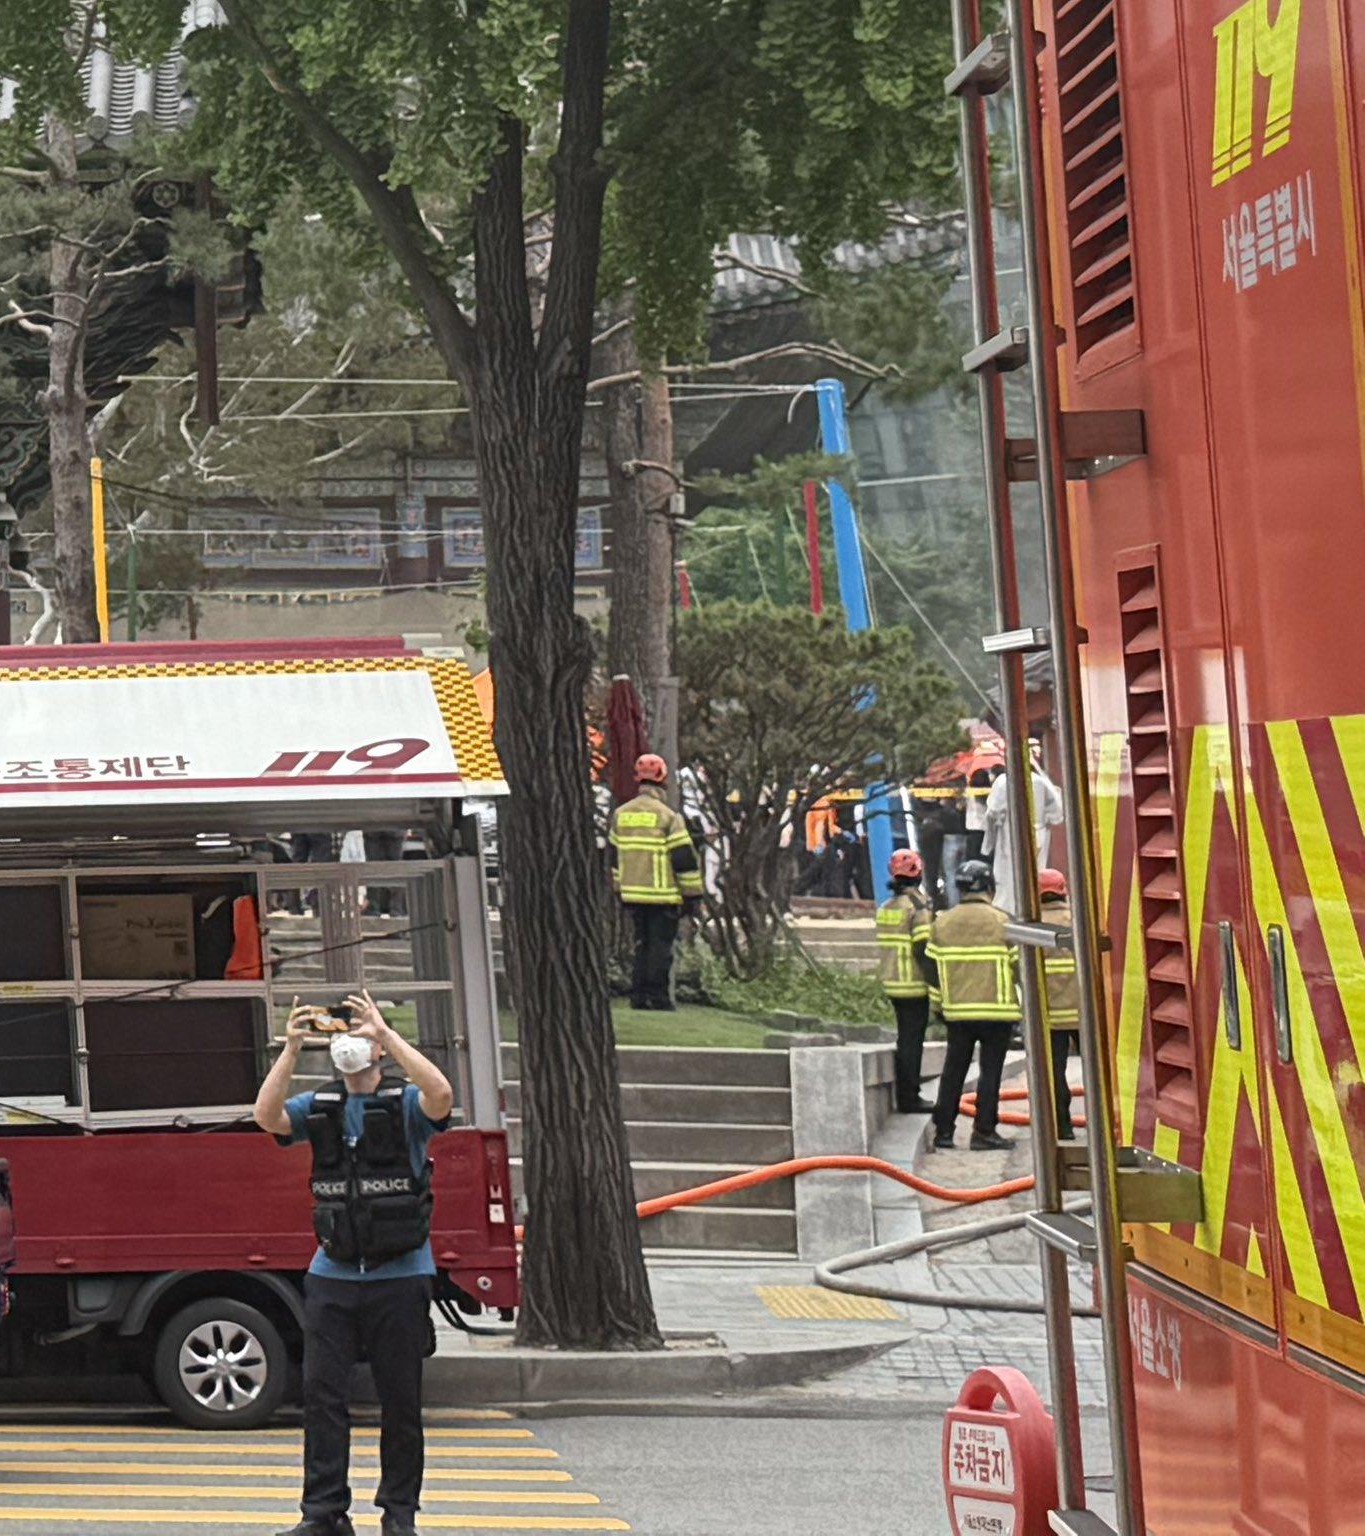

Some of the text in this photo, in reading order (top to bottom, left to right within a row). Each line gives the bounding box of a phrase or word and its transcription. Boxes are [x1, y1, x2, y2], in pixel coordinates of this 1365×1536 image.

[1222, 170, 1317, 294] 서울특별시
[259, 738, 430, 777] 119
[360, 1178, 410, 1193] POLICE
[1127, 1293, 1182, 1392] 서울소방
[953, 1443, 1006, 1486] 주차금지
